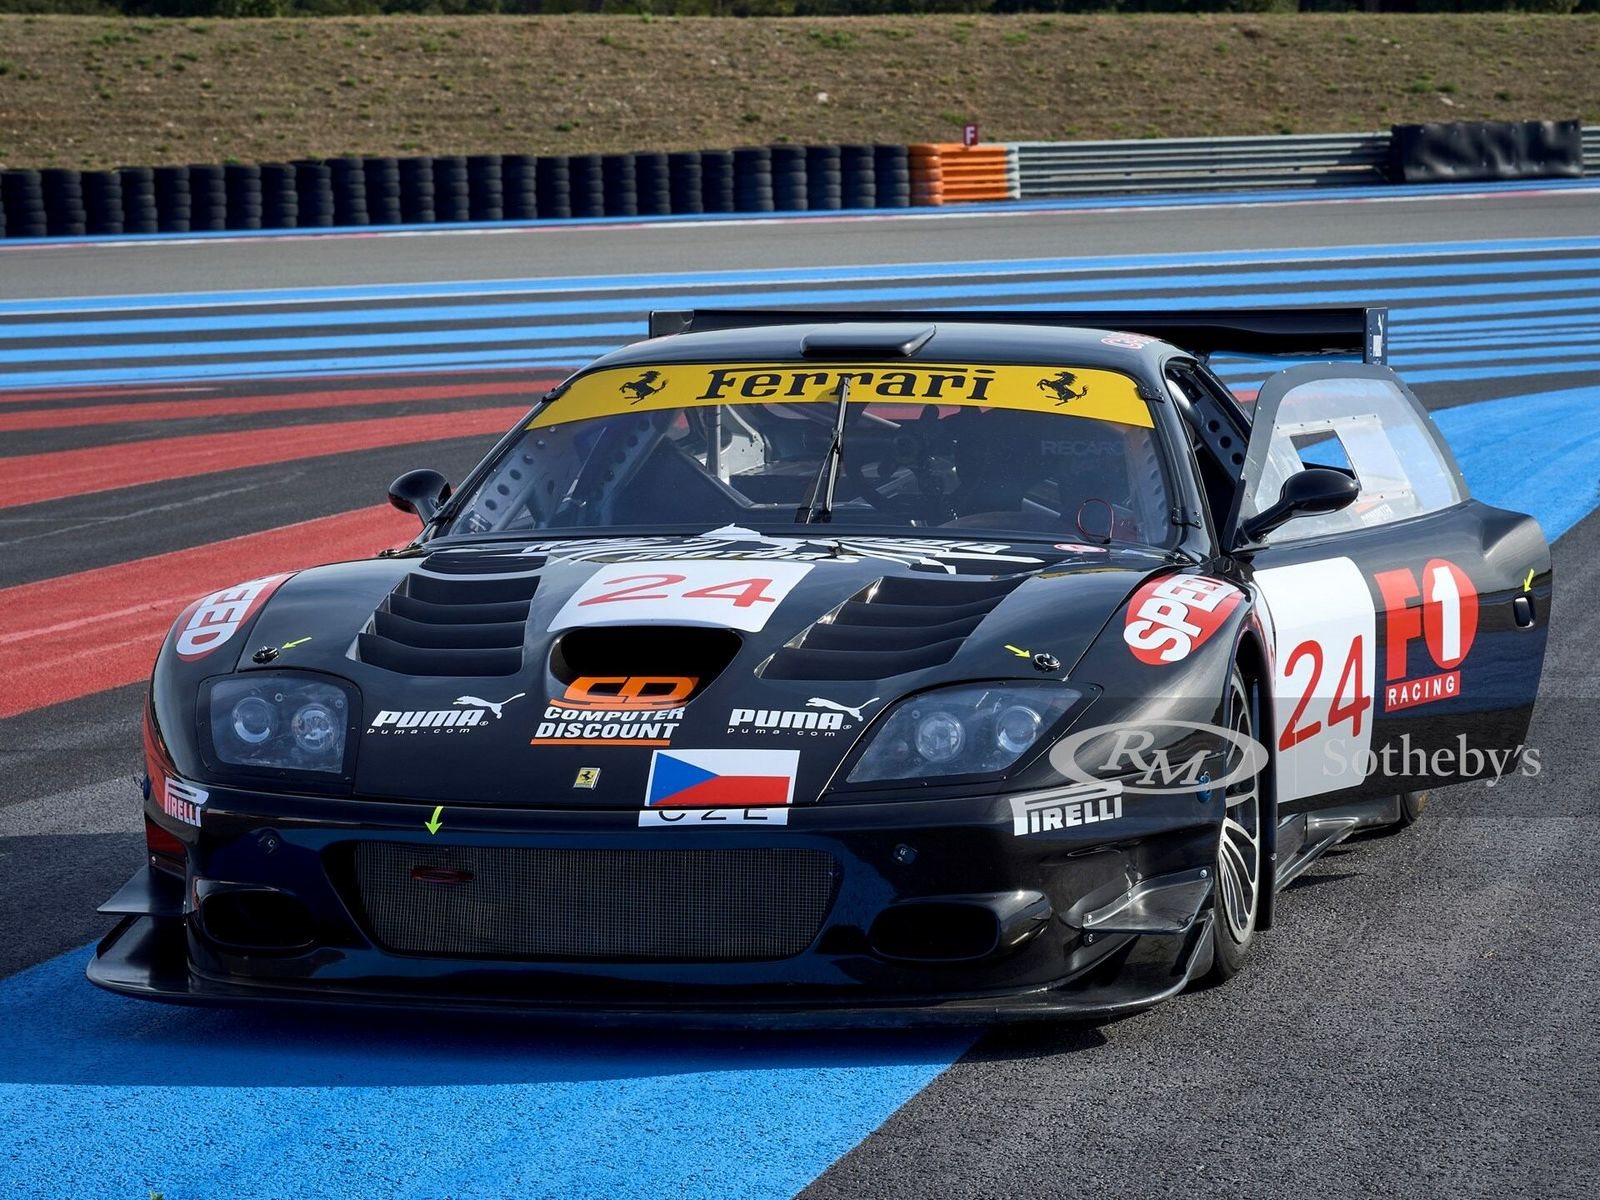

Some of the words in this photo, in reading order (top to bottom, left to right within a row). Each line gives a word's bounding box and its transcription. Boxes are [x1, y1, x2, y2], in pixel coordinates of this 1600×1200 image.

[965, 126, 975, 145] F
[696, 365, 996, 400] Ferrari
[577, 574, 776, 608] 24
[176, 573, 281, 656] EED
[1123, 574, 1240, 662] SPEE
[1374, 563, 1462, 682] F1
[1279, 635, 1371, 752] 24
[1388, 675, 1456, 706] RACING
[535, 722, 680, 739] DISCOUNT
[544, 706, 686, 722] COMPUTER
[164, 776, 210, 828] PIRELLI
[1009, 780, 1124, 837] PIRELLI
